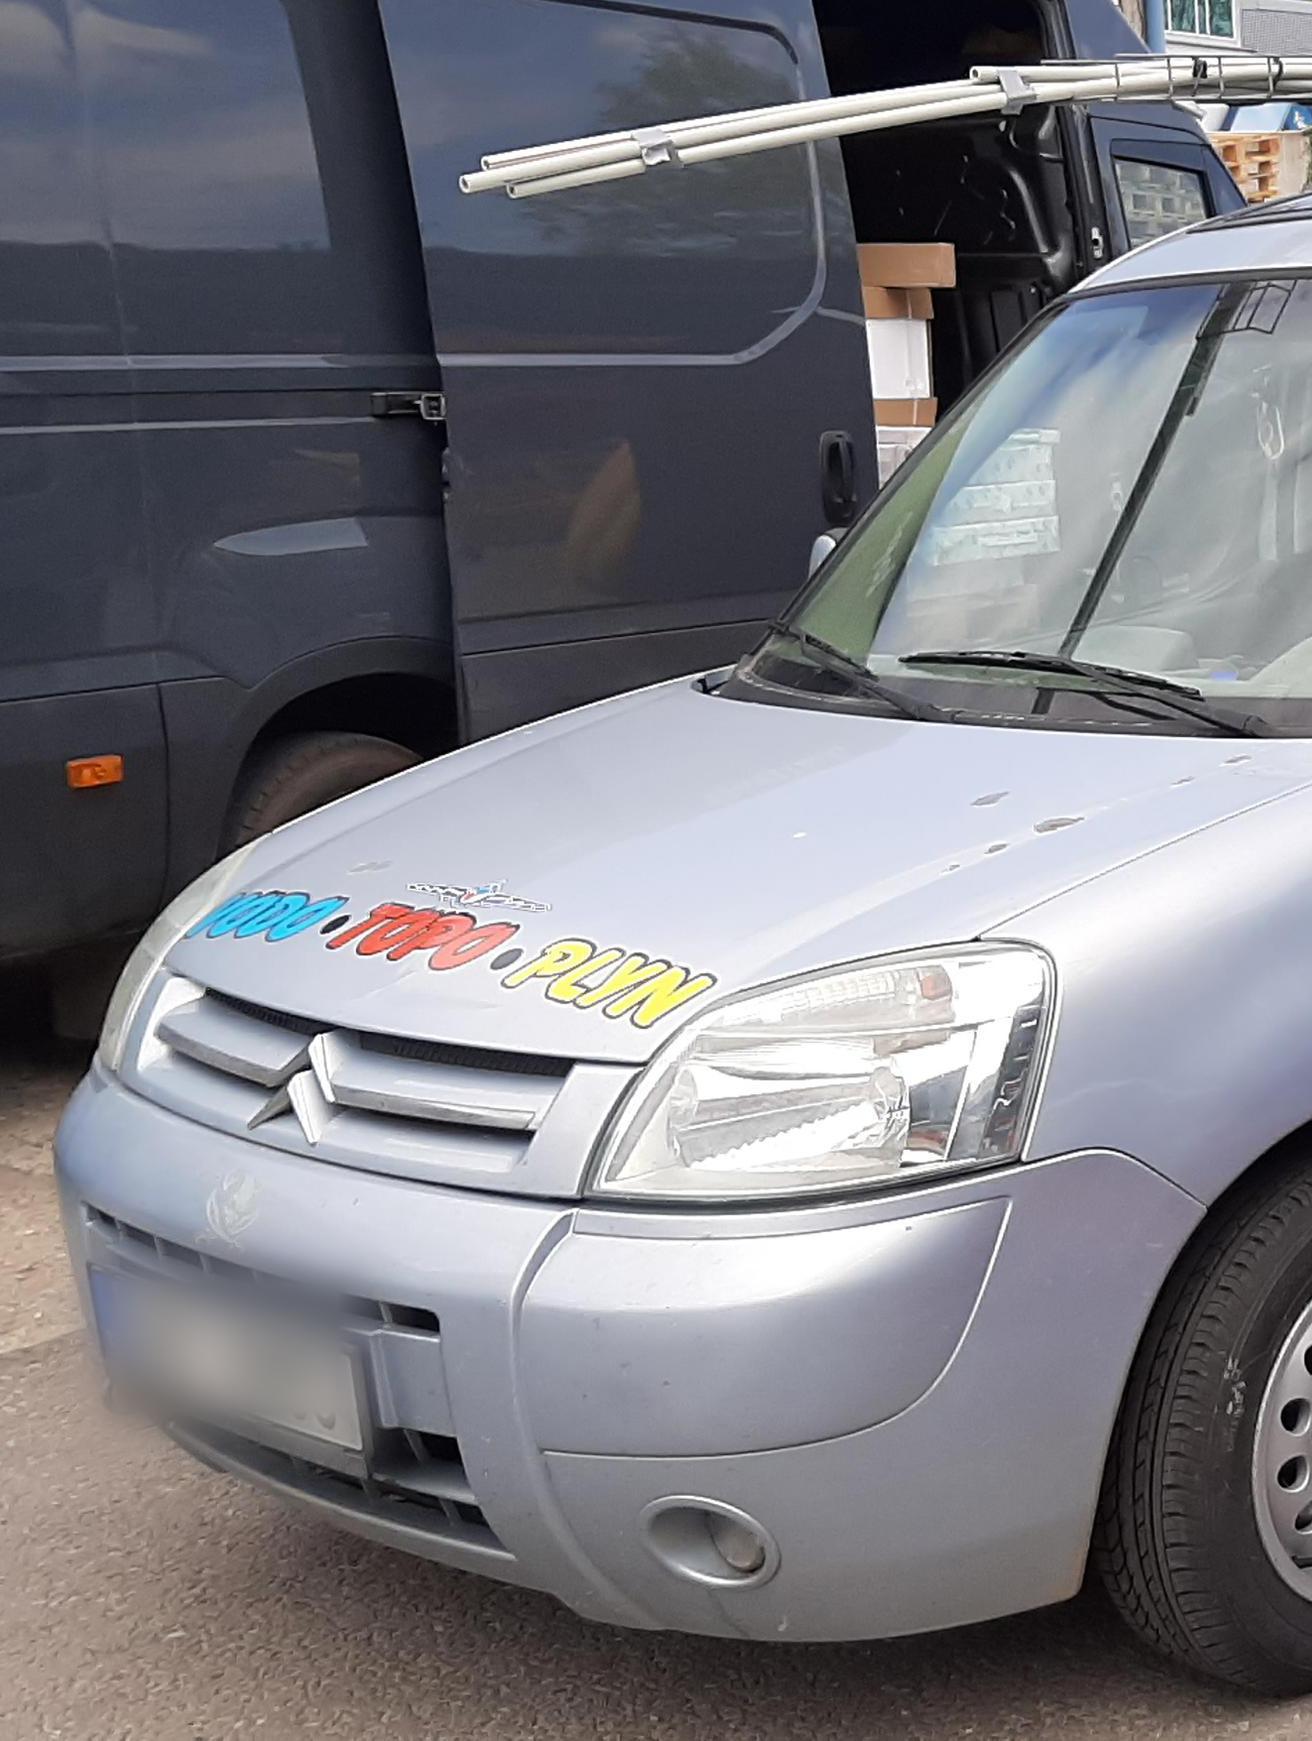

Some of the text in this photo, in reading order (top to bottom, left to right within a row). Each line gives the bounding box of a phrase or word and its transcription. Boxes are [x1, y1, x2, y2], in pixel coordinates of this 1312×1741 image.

[183, 890, 718, 1029] VODO TOPO PLYN
